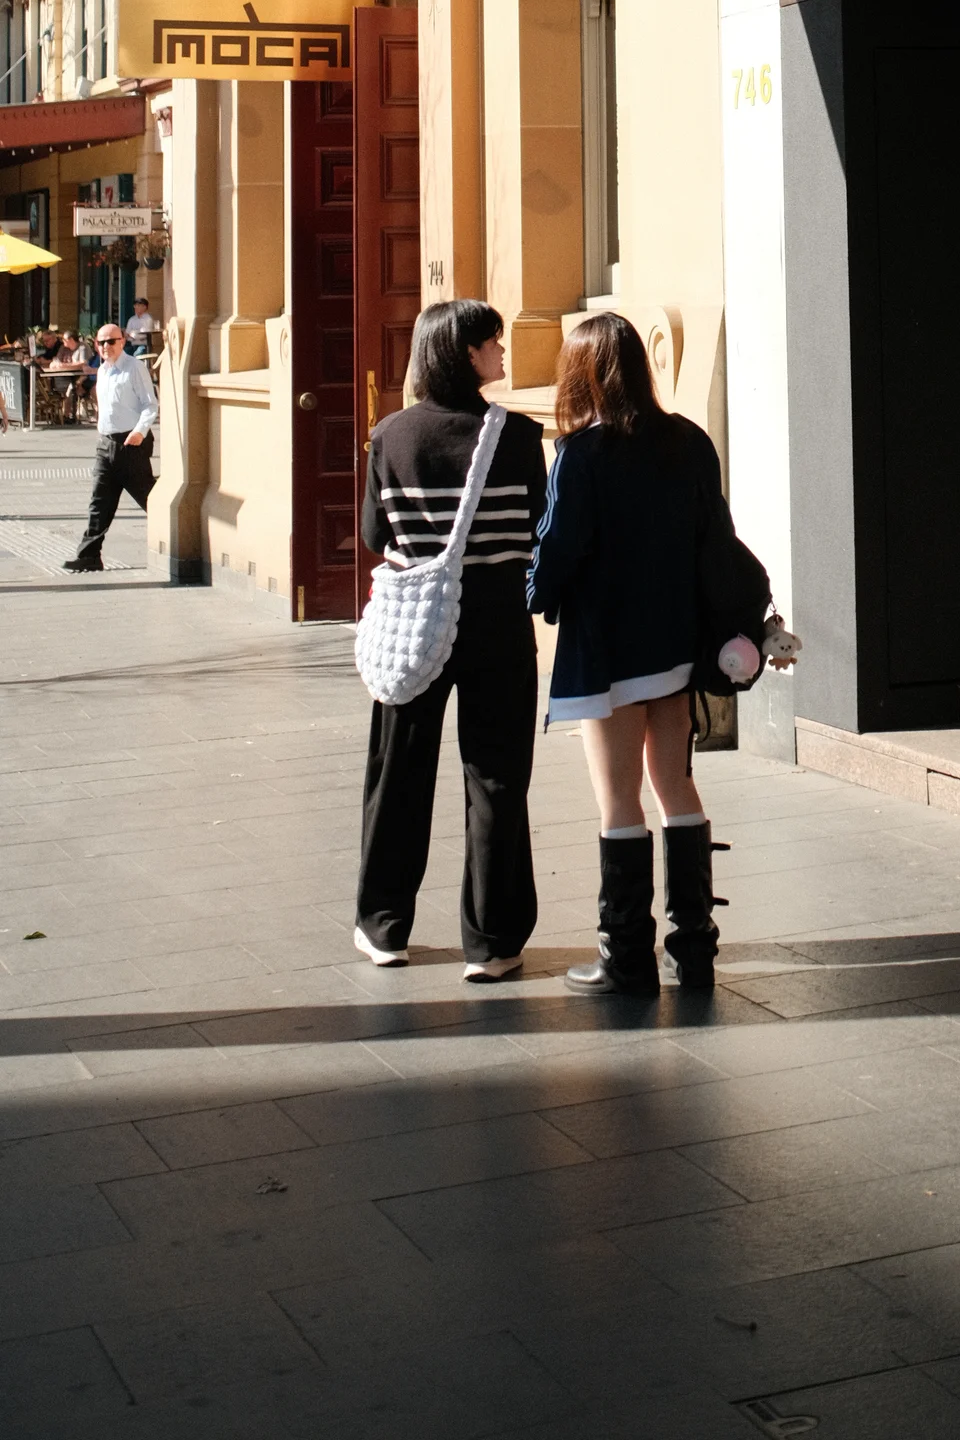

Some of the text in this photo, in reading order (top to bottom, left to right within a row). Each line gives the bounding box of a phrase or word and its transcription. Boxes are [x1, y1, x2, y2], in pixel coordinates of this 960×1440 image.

[731, 63, 772, 110] 746
[82, 216, 148, 227] PALACE HOTEL
[428, 260, 444, 286] 744
